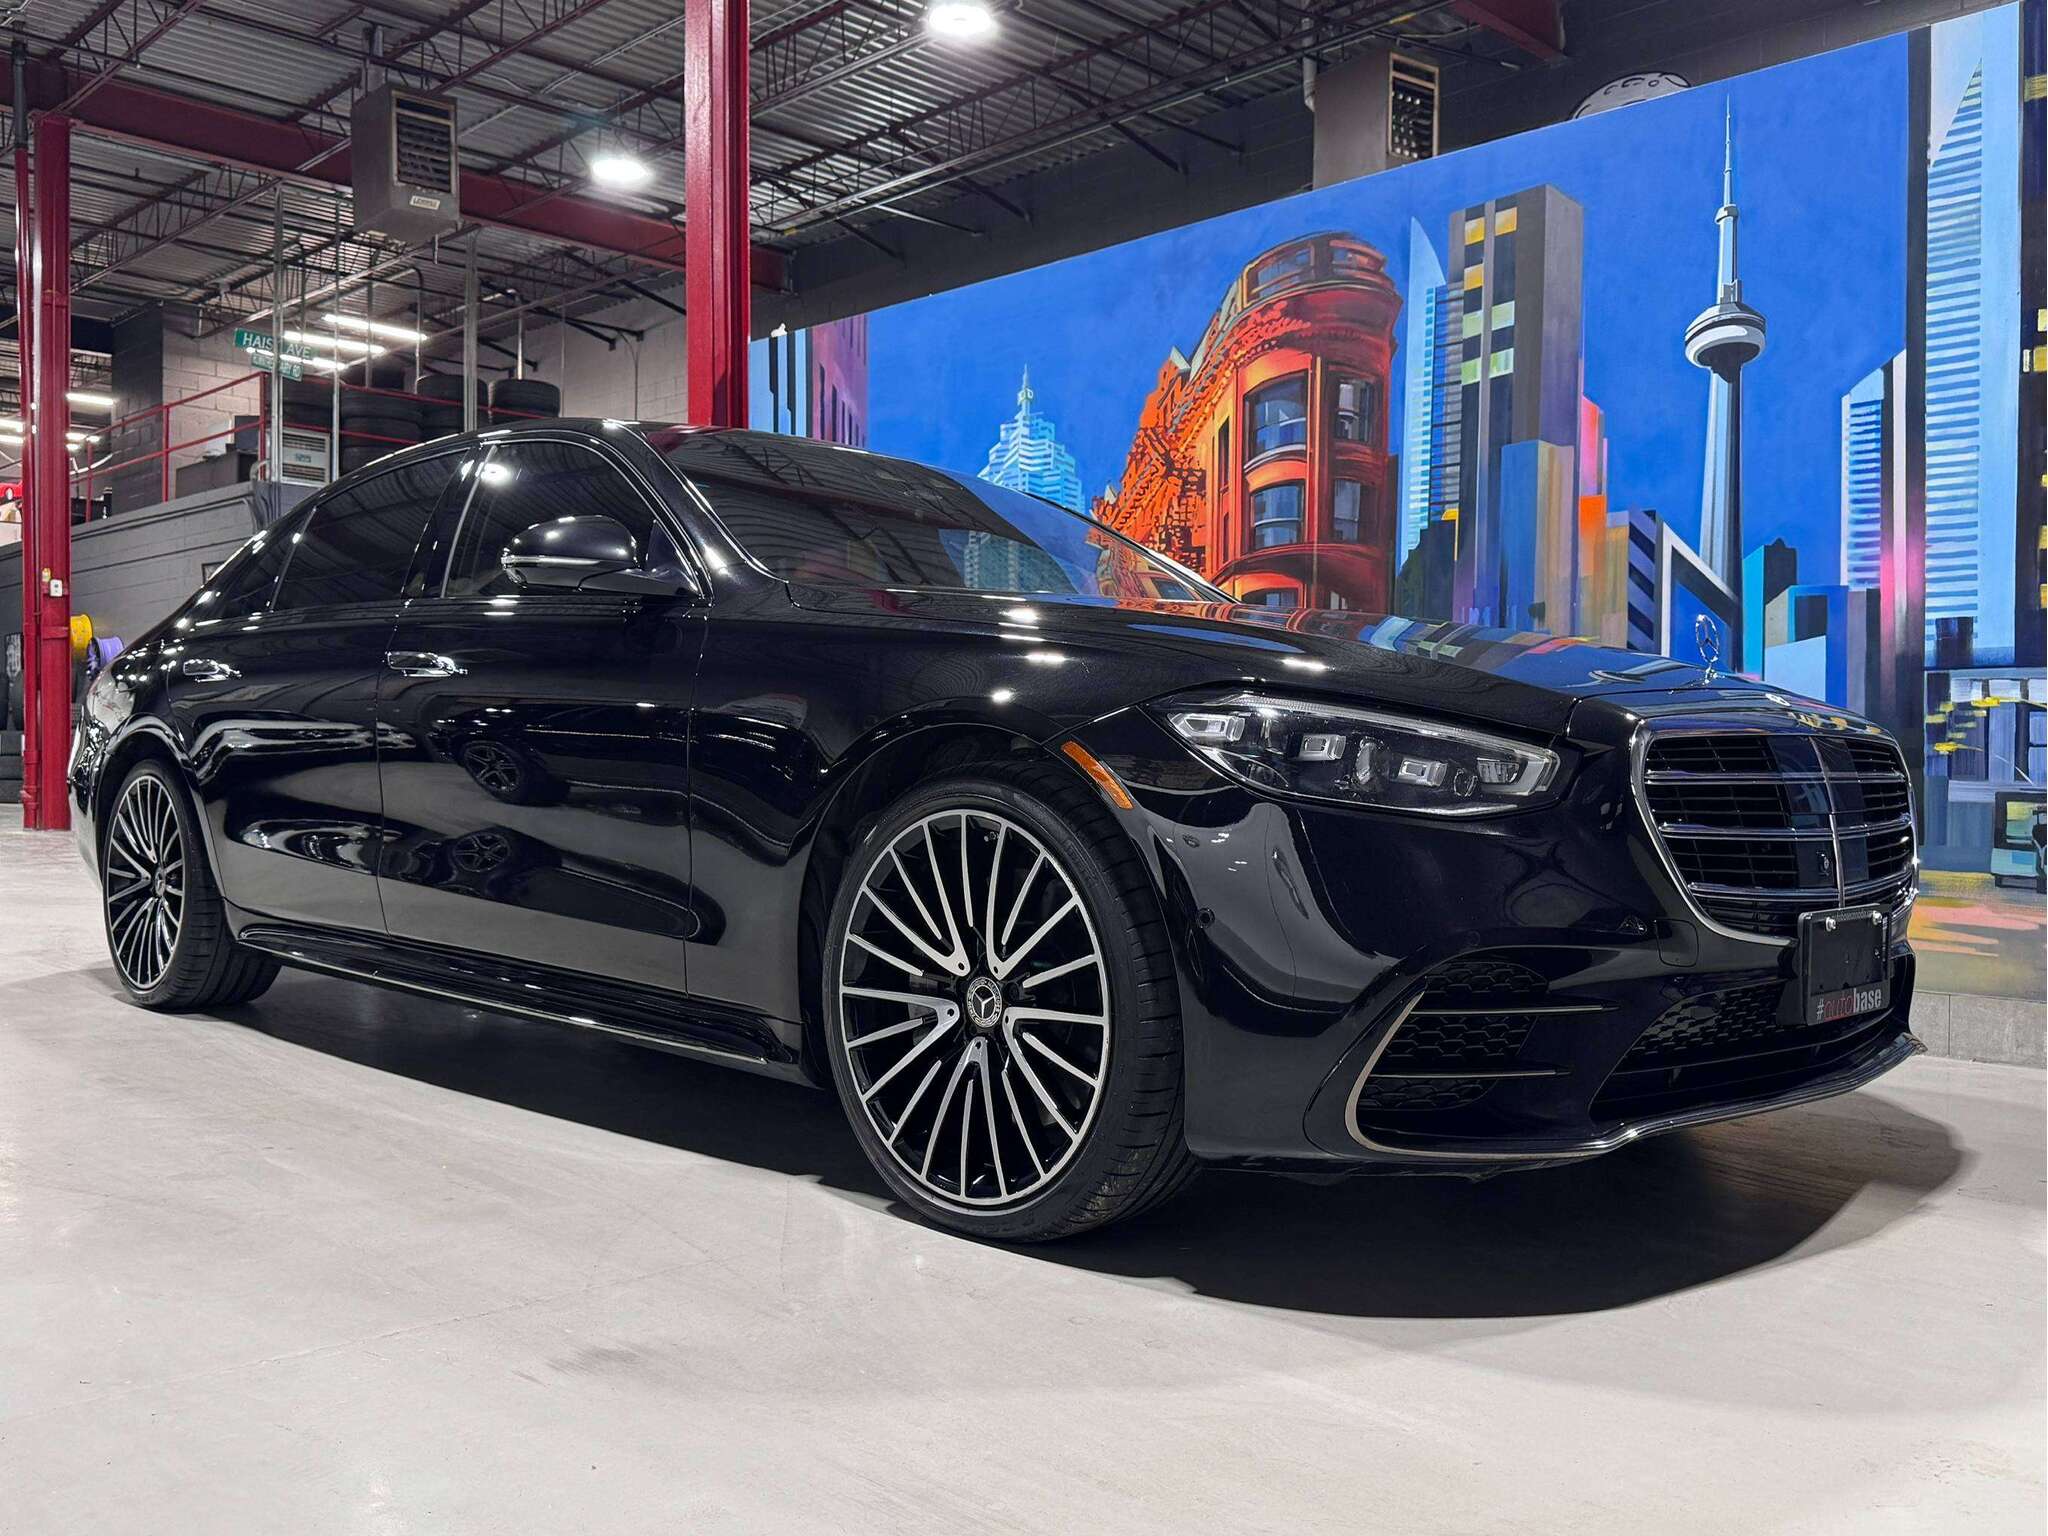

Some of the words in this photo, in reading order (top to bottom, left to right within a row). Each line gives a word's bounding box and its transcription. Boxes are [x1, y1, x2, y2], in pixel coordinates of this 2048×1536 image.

[243, 332, 276, 350] HAIS
[286, 343, 312, 359] AVE
[1817, 987, 1881, 1021] #autobase
